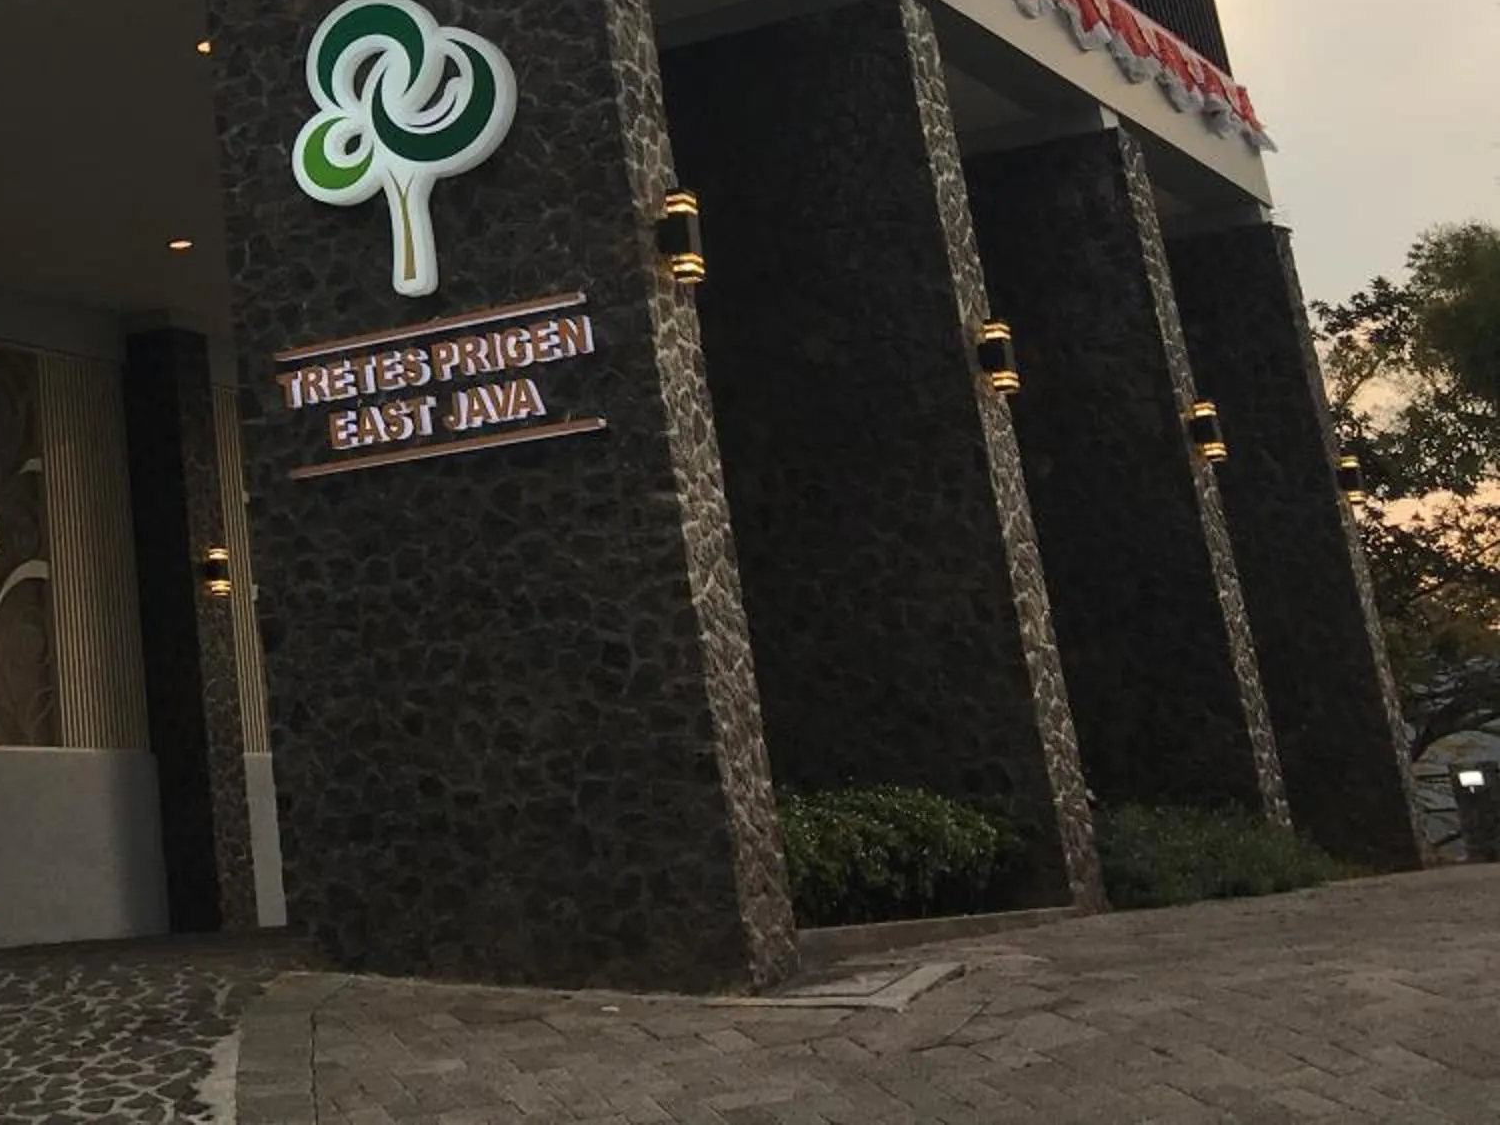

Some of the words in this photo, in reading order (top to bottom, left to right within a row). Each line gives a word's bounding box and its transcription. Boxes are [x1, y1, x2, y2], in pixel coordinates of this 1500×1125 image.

[276, 349, 431, 409] TRETES
[431, 315, 595, 381] PRIGEN
[329, 396, 436, 450] EAST
[443, 378, 547, 430] JAVA
